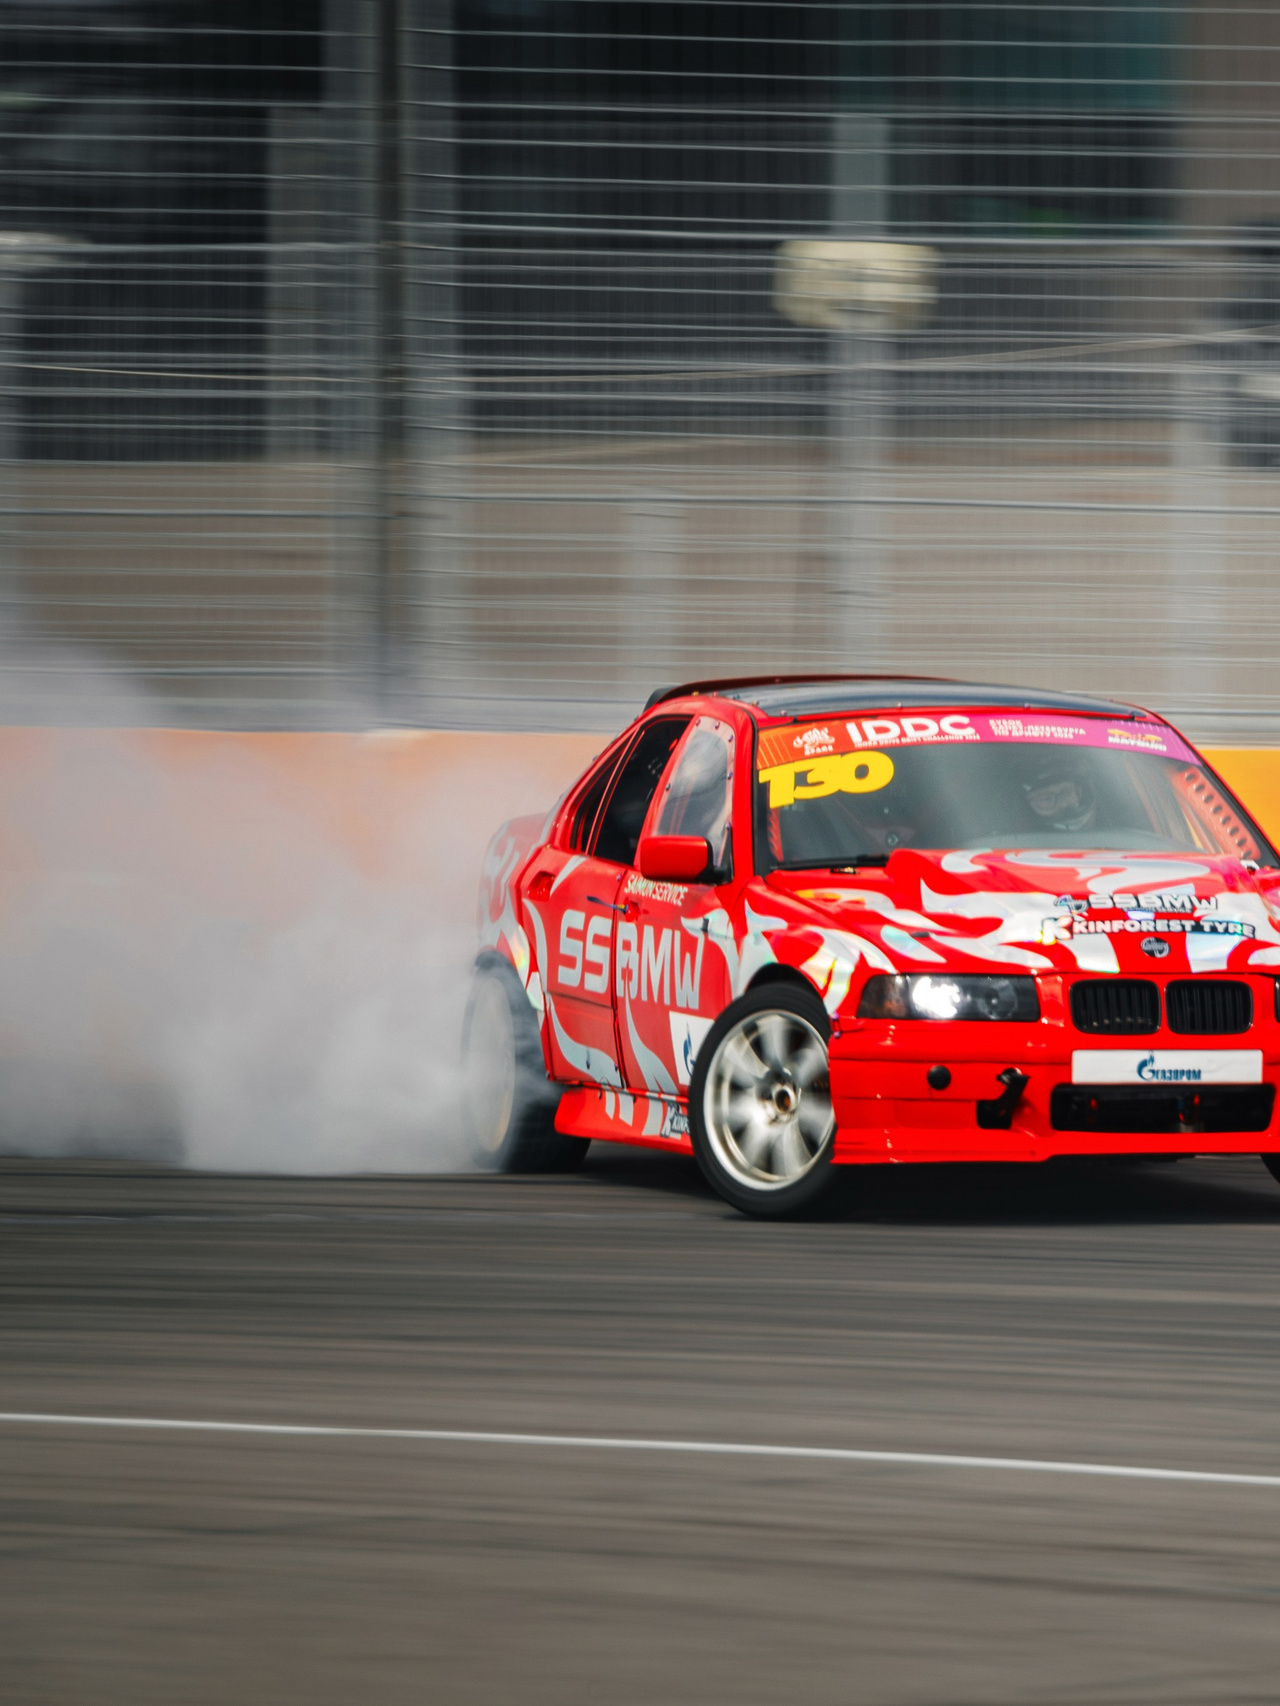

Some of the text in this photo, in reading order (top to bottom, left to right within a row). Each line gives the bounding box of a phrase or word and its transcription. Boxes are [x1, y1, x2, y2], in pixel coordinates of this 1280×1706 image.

[845, 715, 976, 743] IDDC
[1088, 893, 1218, 911] SSBMW
[1073, 919, 1197, 935] KINFOREST
[1200, 920, 1256, 938] TYRE
[558, 909, 705, 1010] SSBMW
